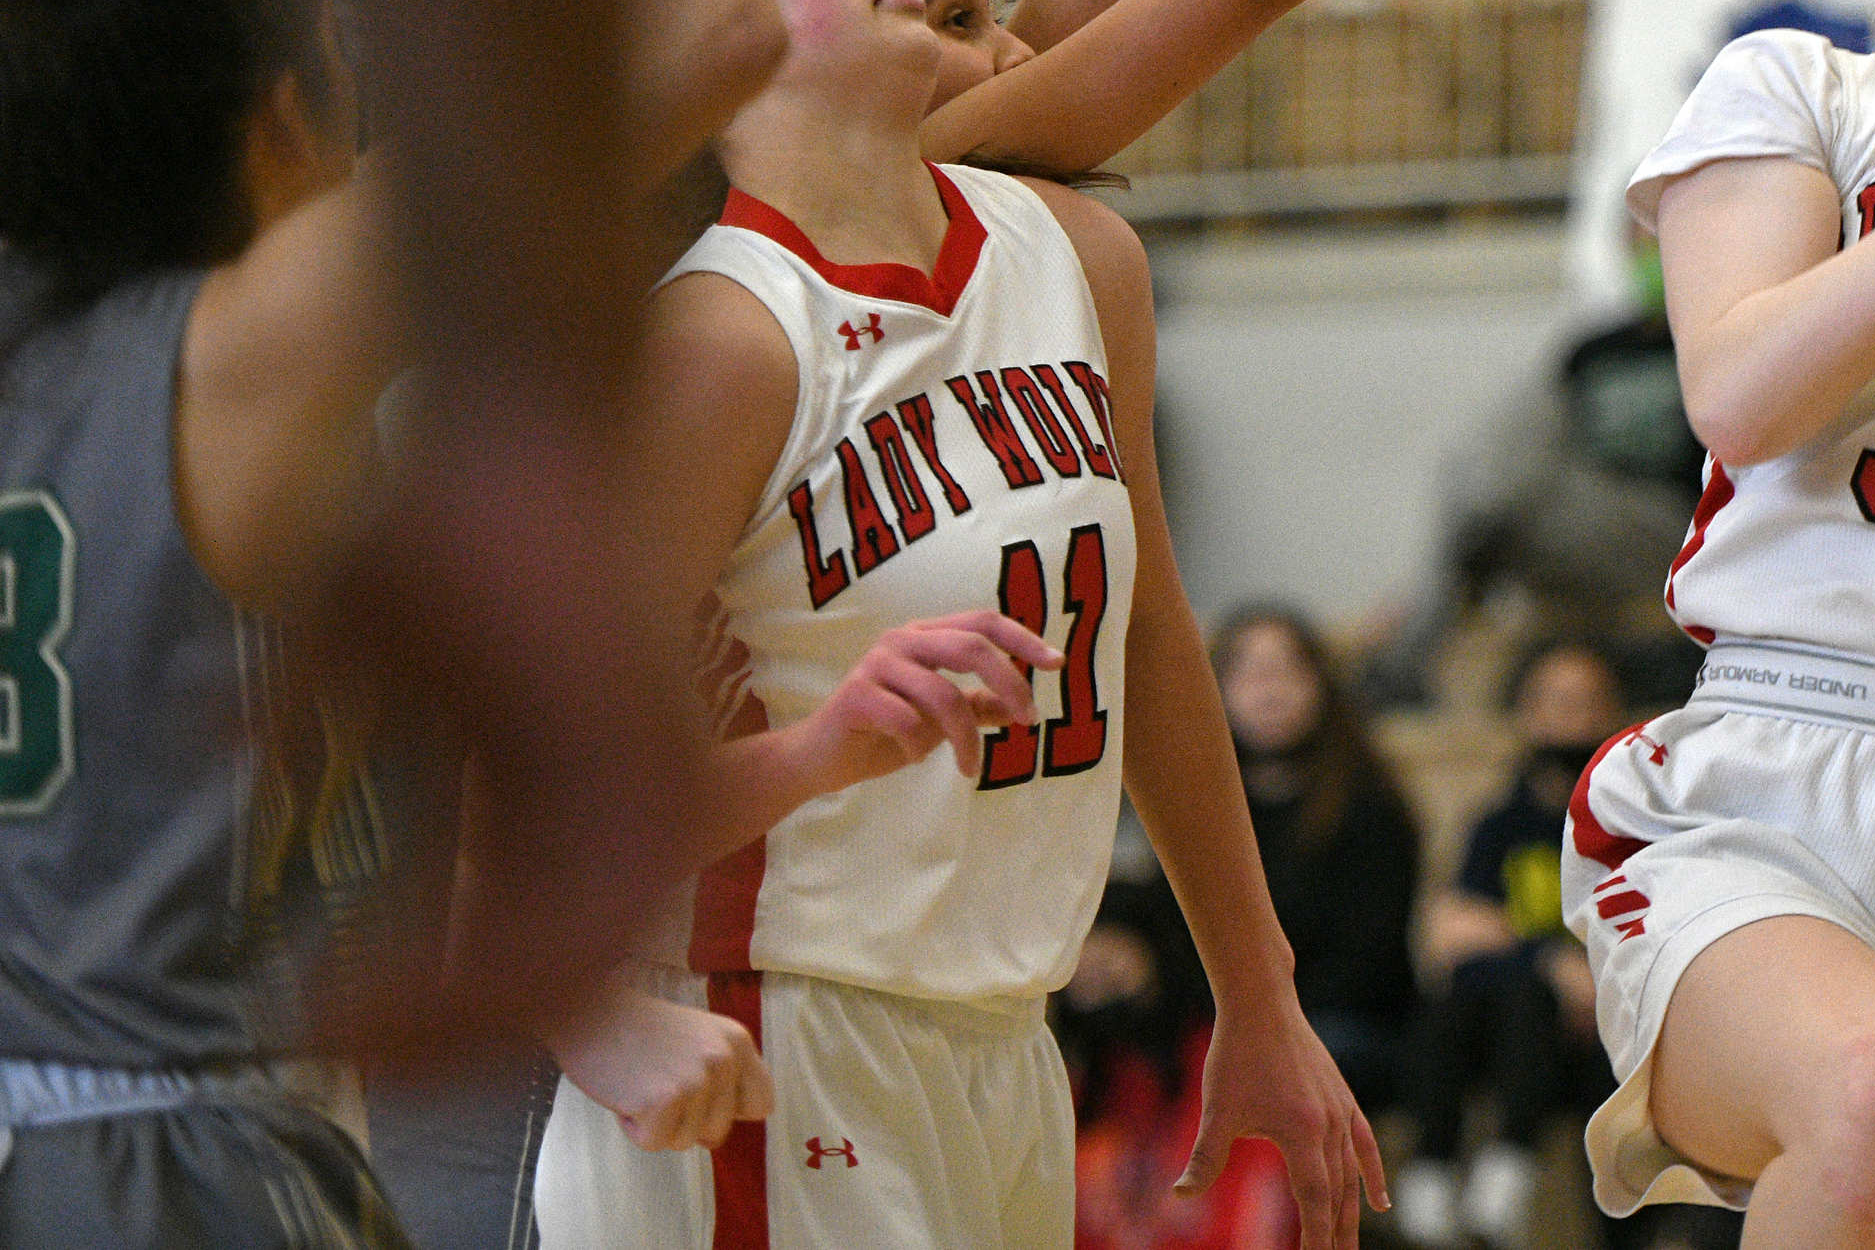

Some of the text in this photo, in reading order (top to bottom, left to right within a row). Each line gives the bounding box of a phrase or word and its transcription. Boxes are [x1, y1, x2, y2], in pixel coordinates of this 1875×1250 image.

[787, 392, 972, 611] LADY
[975, 522, 1109, 791] 11
[1709, 665, 1868, 700] UNDER ARMOUR
